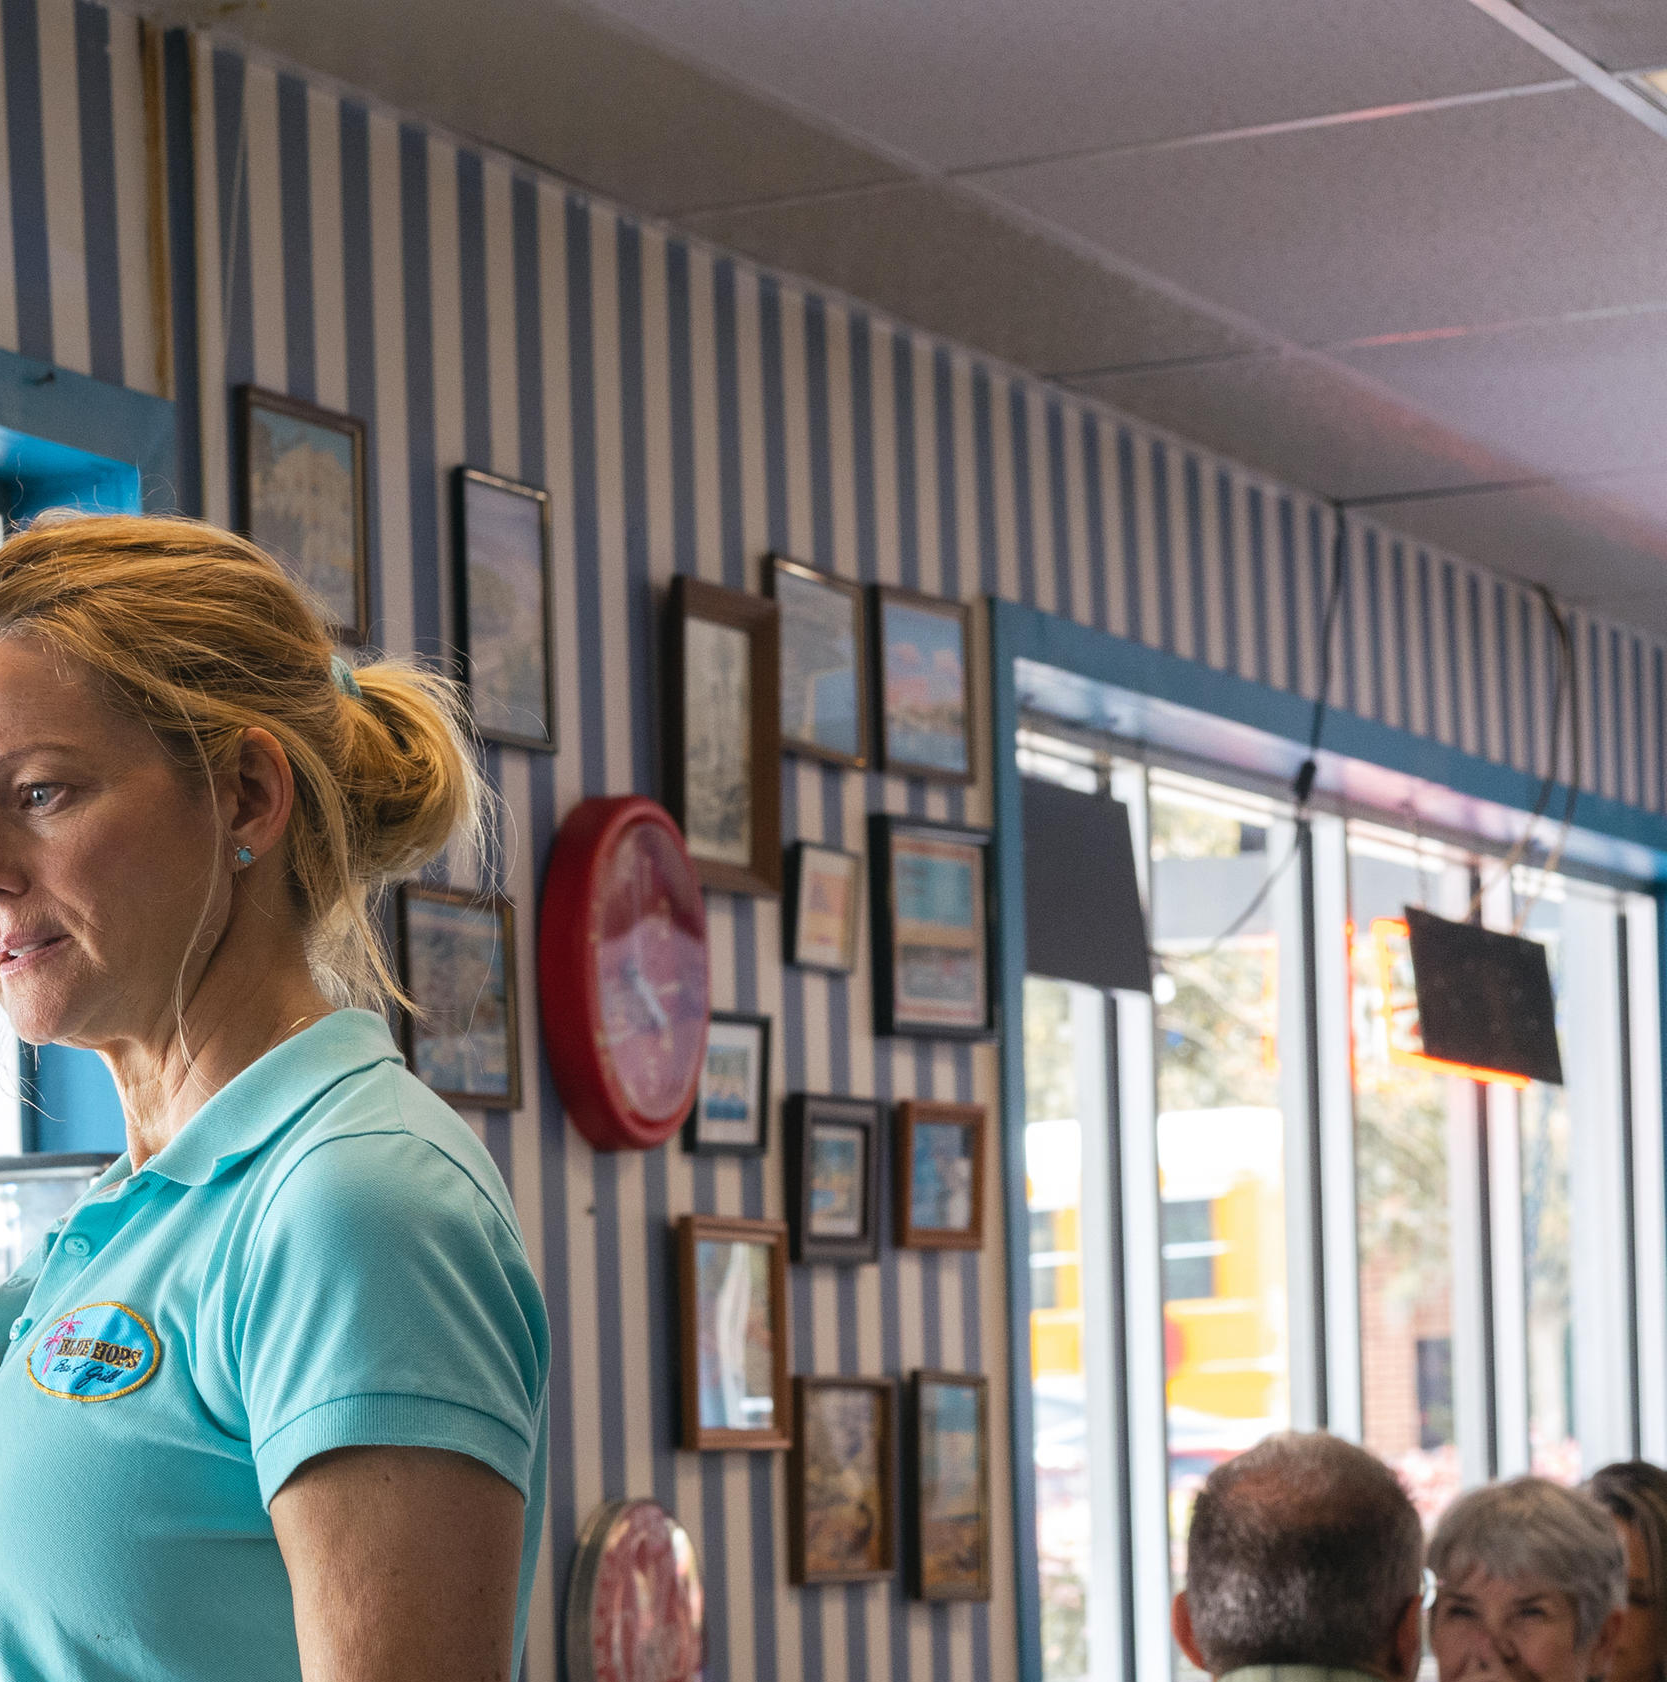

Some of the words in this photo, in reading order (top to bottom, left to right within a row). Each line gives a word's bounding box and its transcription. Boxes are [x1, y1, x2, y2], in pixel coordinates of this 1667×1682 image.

[57, 1337, 93, 1357] BLUE
[89, 1339, 145, 1371] HOPS
[74, 1365, 125, 1390] Grill
